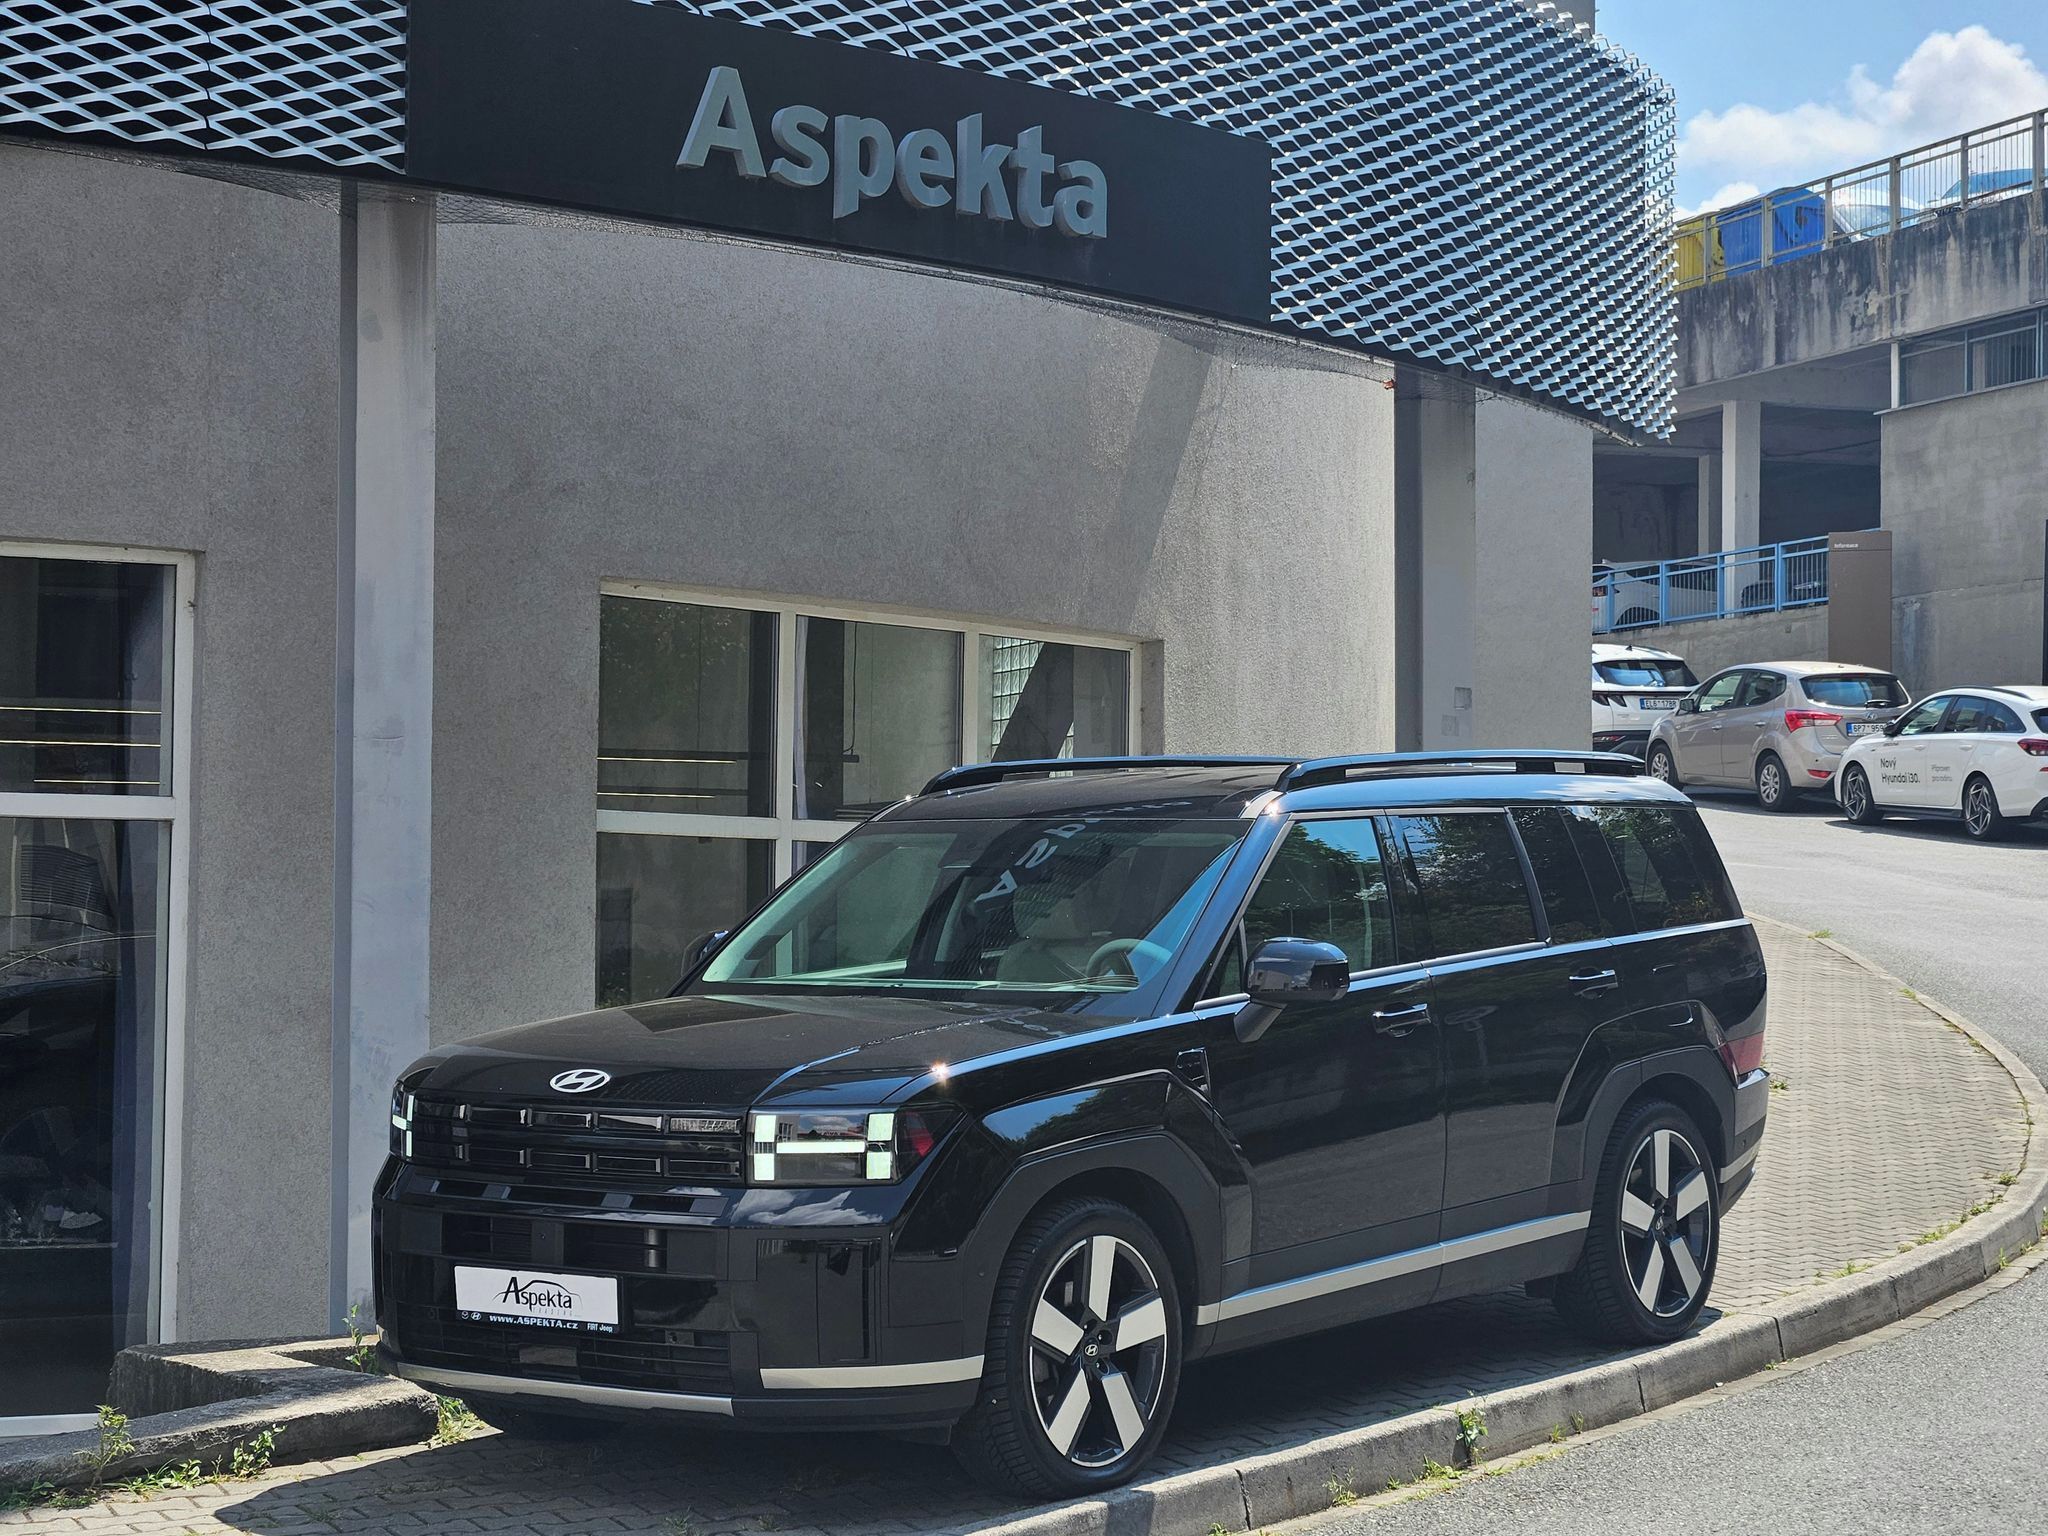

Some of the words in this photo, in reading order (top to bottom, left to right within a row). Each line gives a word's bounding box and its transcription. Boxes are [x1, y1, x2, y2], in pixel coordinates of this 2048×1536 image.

[676, 66, 1107, 238] Aspekta
[1880, 757, 1897, 770] Nový
[1881, 772, 1907, 785] Hyundai
[502, 1276, 572, 1312] Aspekta
[489, 1314, 579, 1330] www.ASPEKTA.cz
[599, 1324, 613, 1333] Jeep
